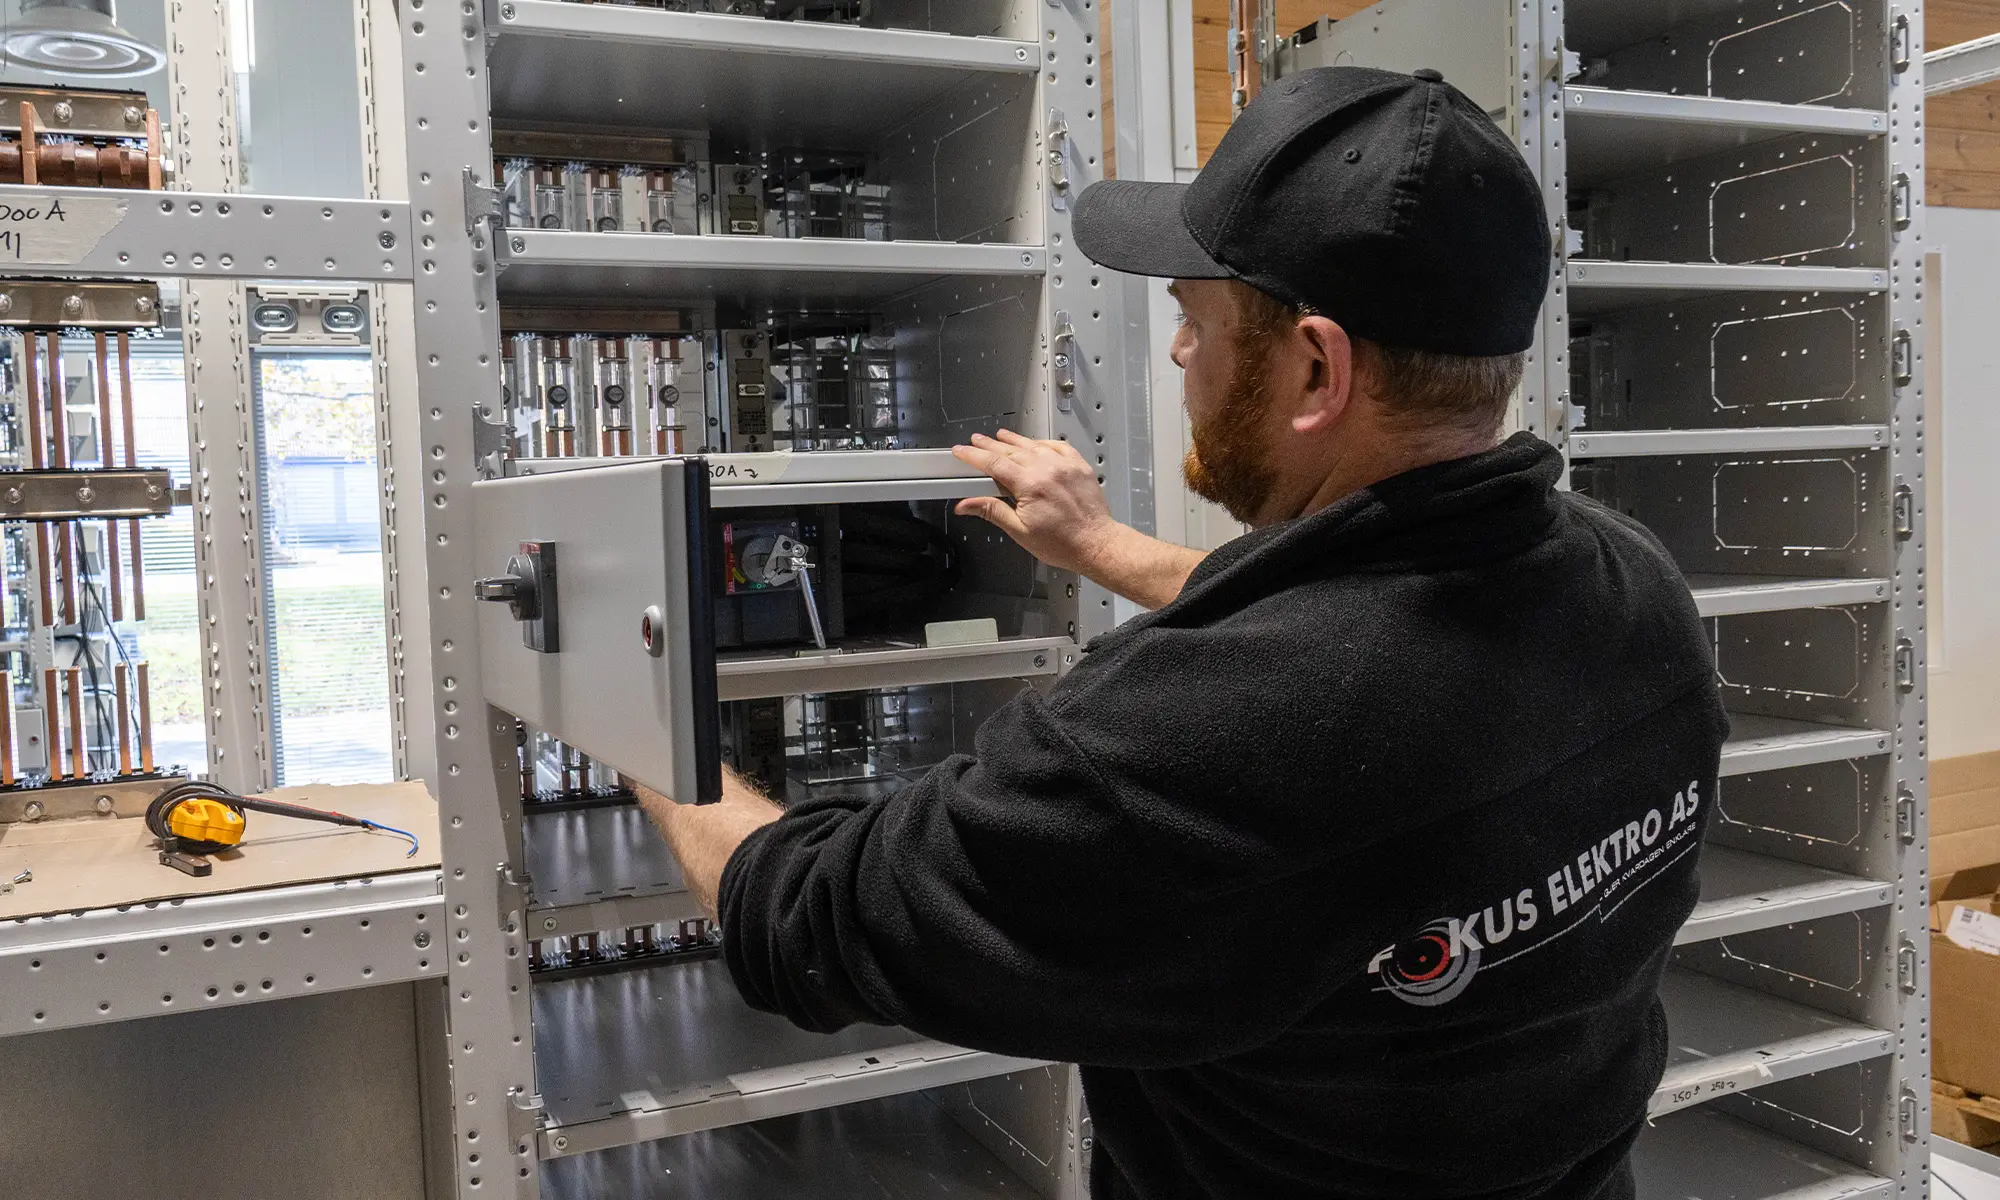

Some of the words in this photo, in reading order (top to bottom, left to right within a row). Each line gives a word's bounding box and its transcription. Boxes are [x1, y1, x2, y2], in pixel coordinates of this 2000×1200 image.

[1548, 809, 1662, 916] ELEKTRO
[1668, 780, 1699, 831] AS
[1622, 845, 1665, 882] KVARDAGEN
[1666, 821, 1696, 849] ENKLARE
